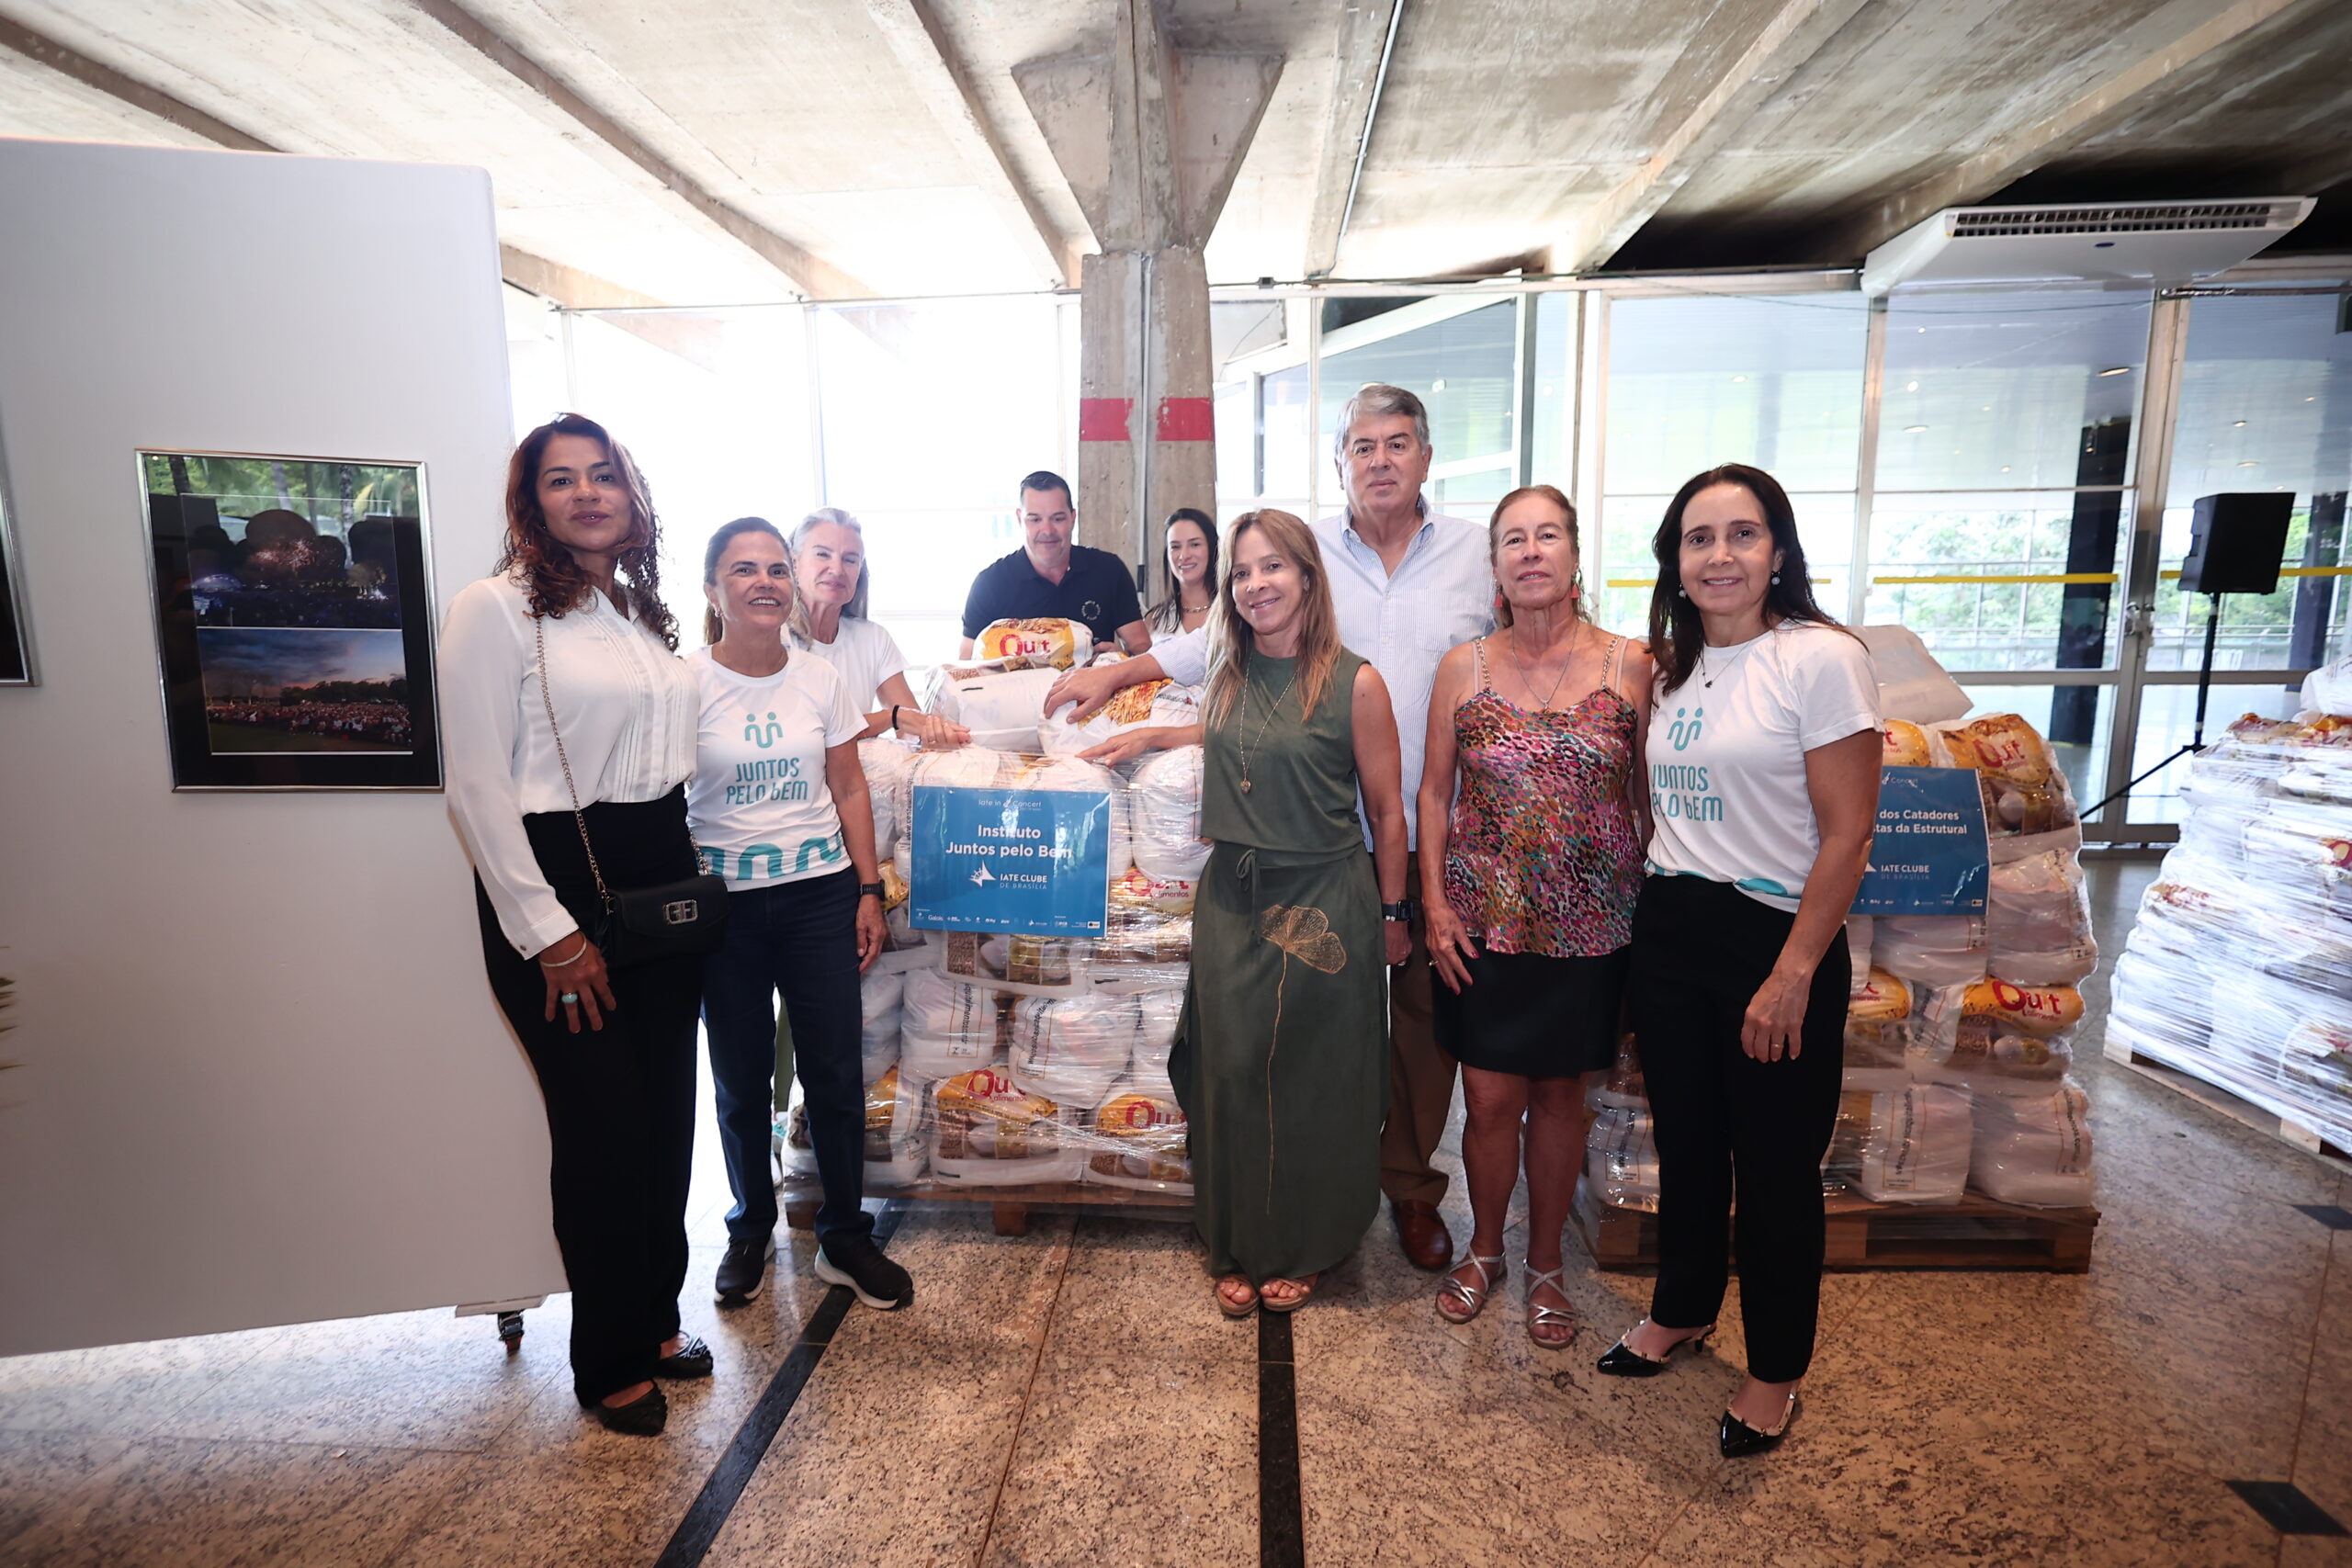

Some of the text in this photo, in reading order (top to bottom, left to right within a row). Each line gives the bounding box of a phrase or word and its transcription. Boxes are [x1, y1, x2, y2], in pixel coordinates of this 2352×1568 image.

[736, 758, 799, 782] JUNTOS
[726, 783, 766, 805] PELO
[1879, 809, 1960, 820] dos Catadores
[1895, 823, 1910, 833] da
[1914, 824, 1967, 835] Estrutural
[945, 841, 1072, 858] Juntos pelo Bem
[1881, 864, 1929, 873] IATE CLUBE
[1000, 874, 1047, 883] IATE CLUBE
